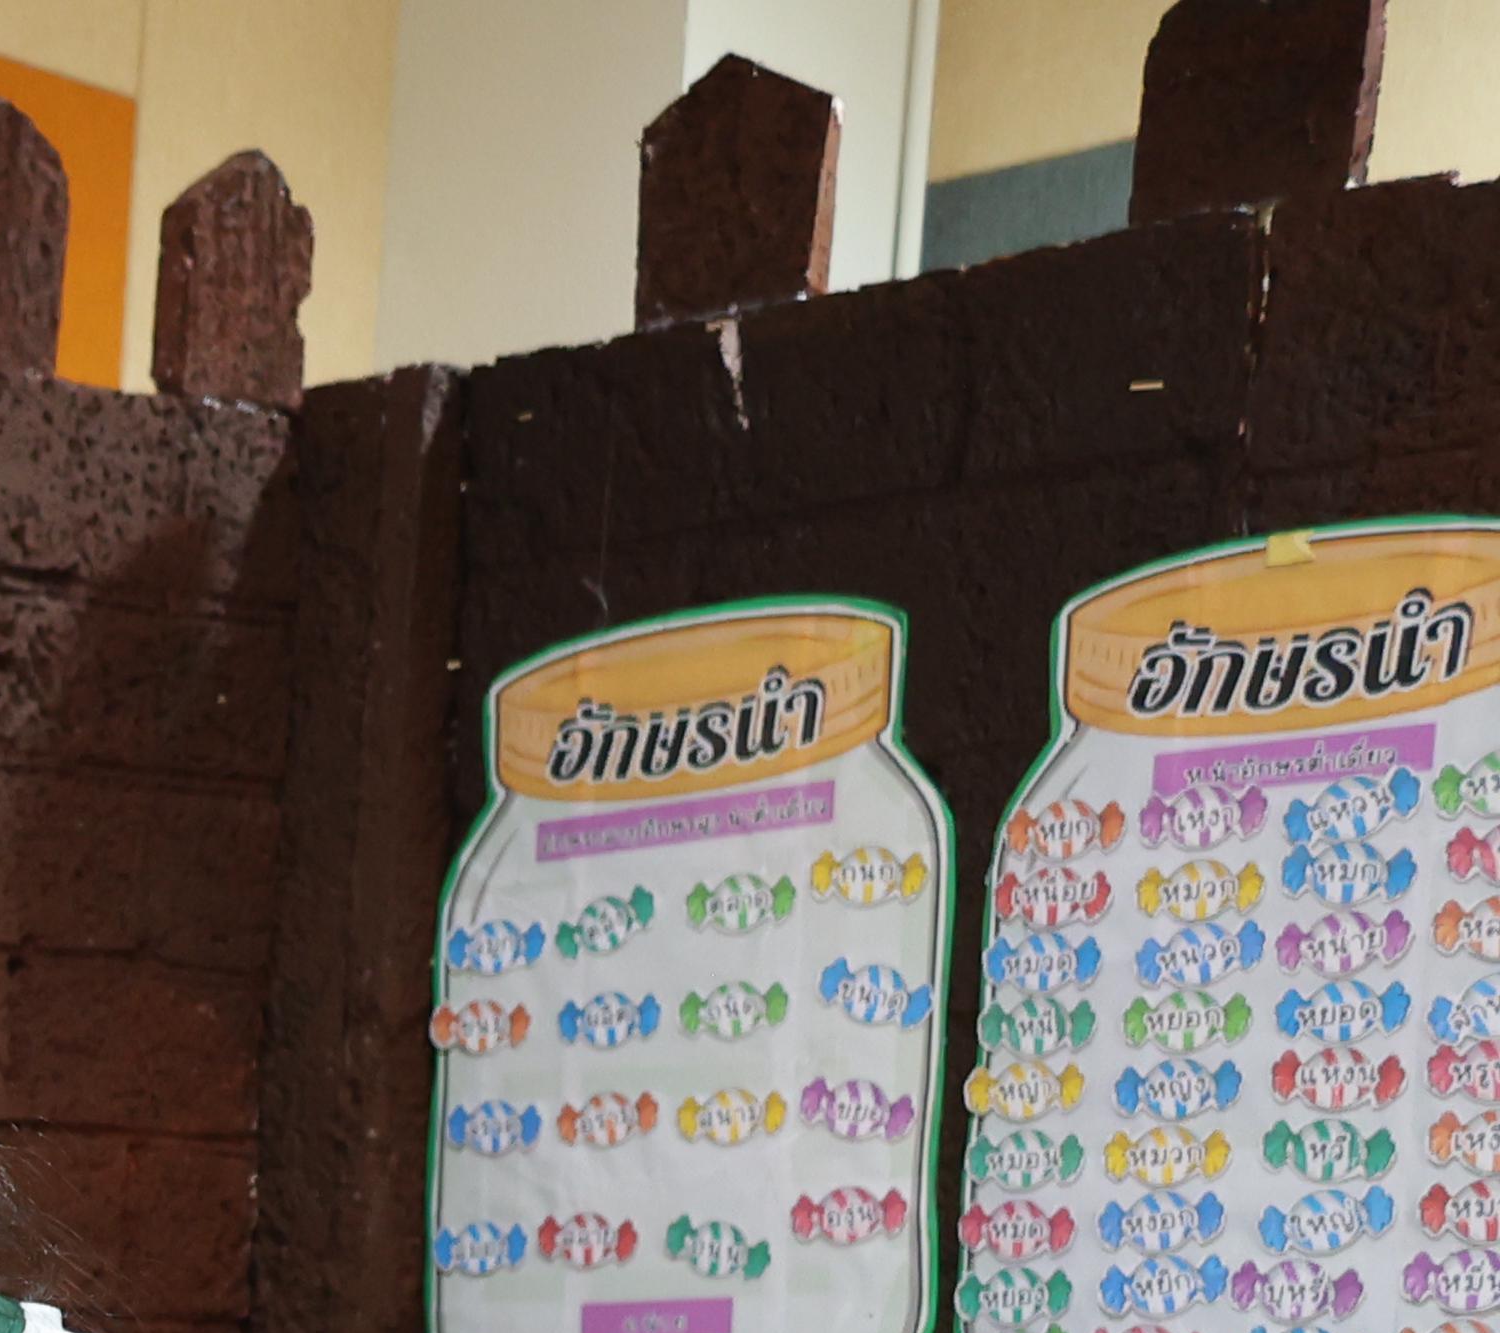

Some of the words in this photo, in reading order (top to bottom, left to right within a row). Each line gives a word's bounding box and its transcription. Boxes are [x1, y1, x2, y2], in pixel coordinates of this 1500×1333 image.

[1128, 590, 1470, 718] อักษรนำ
[548, 668, 824, 785] อักษรนำ
